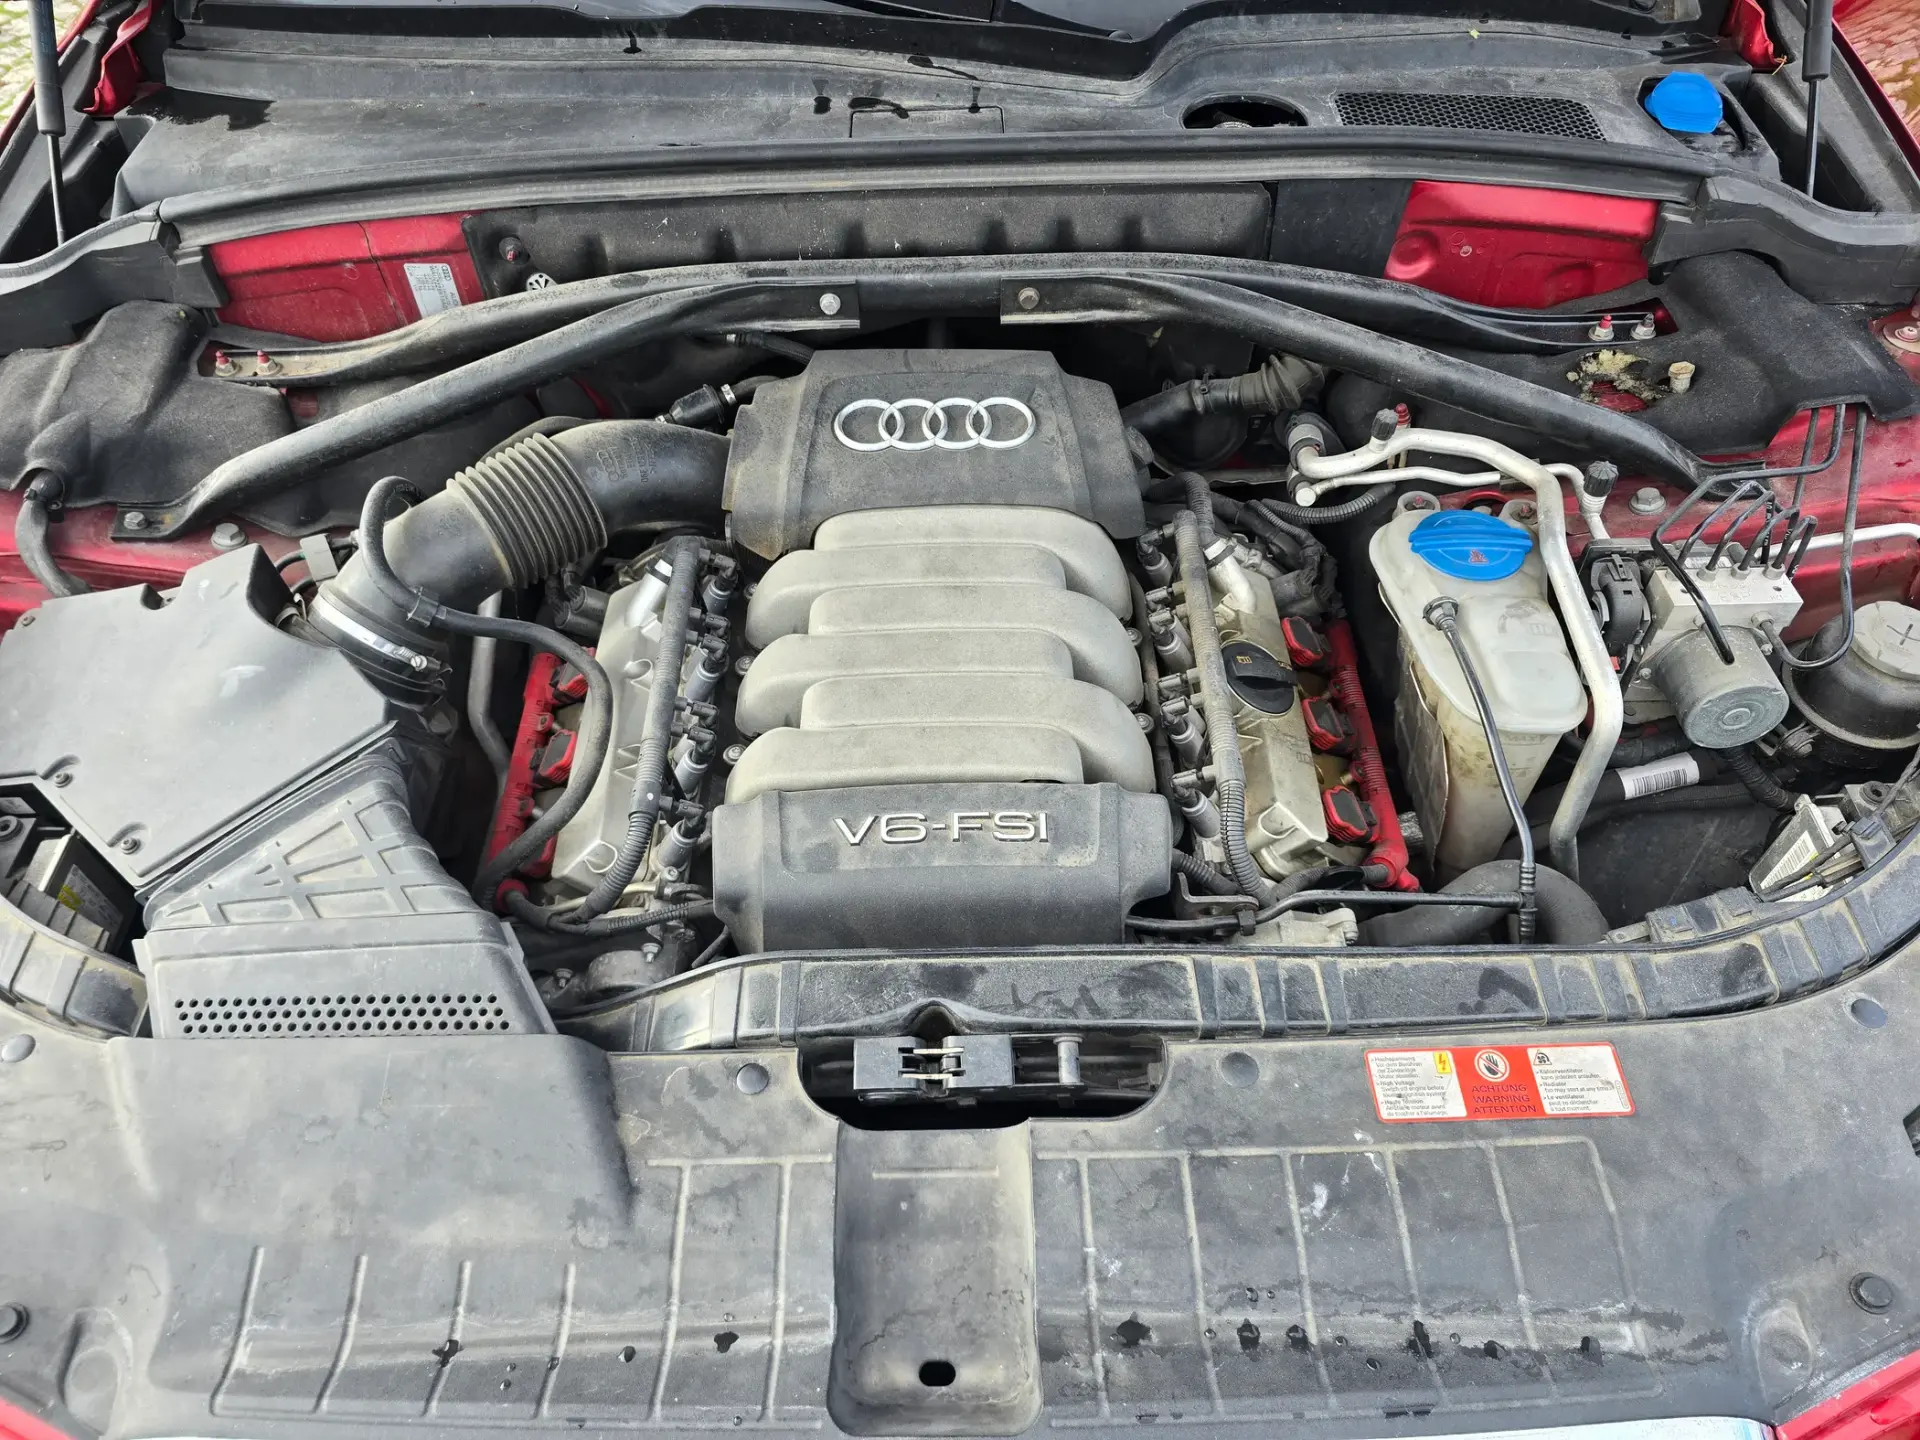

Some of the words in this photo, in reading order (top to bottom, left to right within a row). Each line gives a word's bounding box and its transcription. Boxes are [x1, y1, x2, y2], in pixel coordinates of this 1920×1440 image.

[833, 811, 1049, 846] V6-FSI
[1472, 1084, 1527, 1092] ACHTUNG
[1472, 1094, 1530, 1104] WARNING
[1473, 1104, 1537, 1114] ATTENTION
